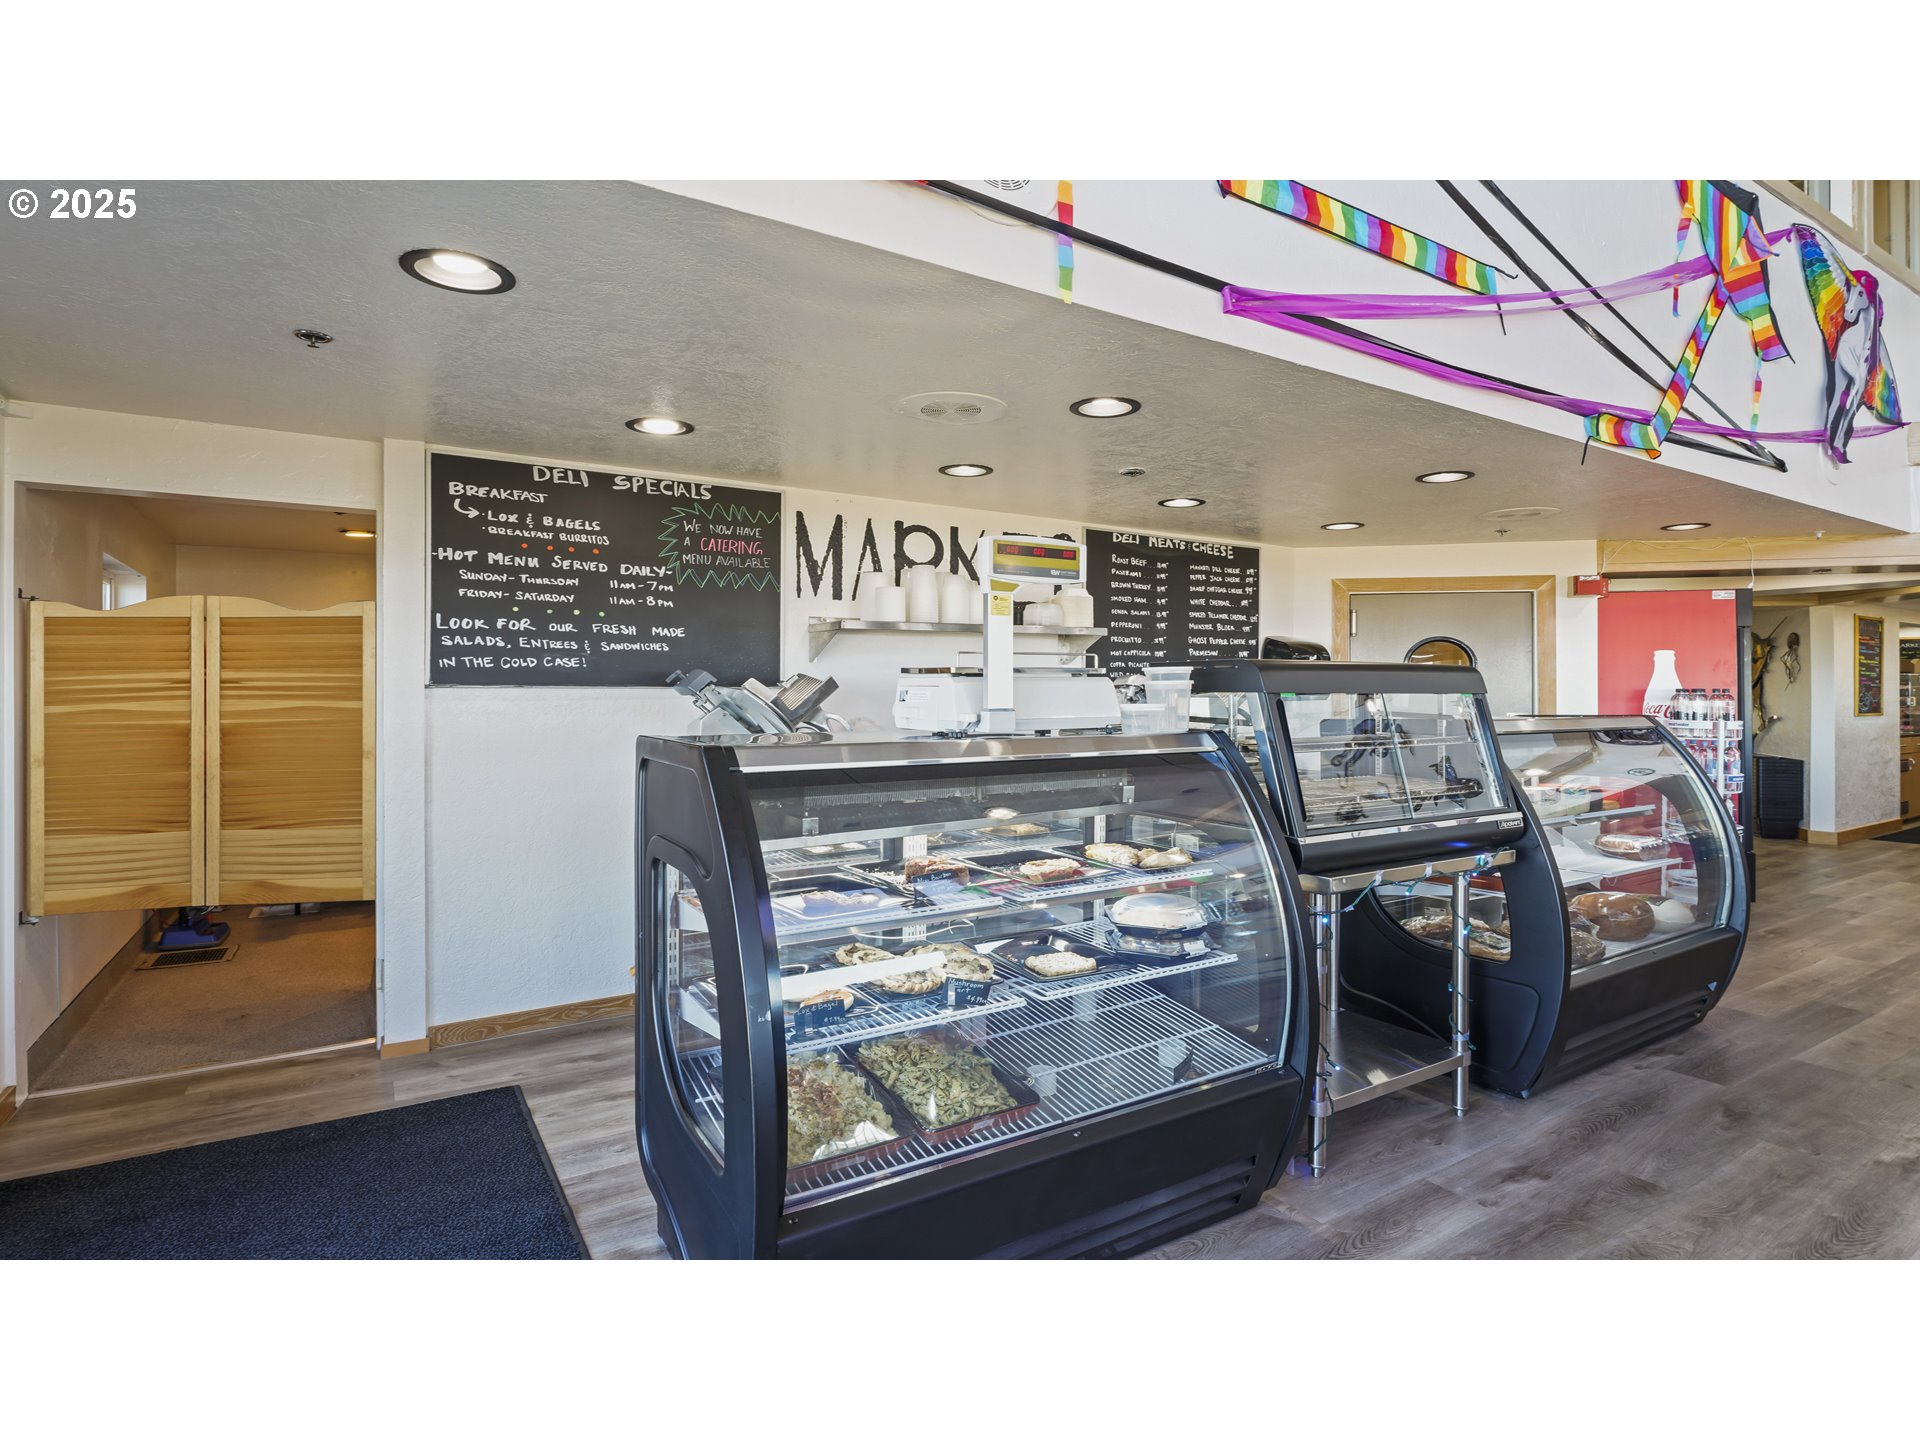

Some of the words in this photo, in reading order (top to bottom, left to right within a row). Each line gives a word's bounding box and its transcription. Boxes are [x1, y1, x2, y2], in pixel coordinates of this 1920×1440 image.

[532, 465, 590, 488] DELI
[612, 475, 713, 500] SPECIALS
[448, 481, 549, 503] BREAKFAST
[487, 510, 519, 523] LOX
[542, 515, 601, 531] BAGELS
[683, 518, 702, 534] WE
[709, 523, 733, 536] NOW
[736, 526, 763, 539] HAVE
[487, 525, 554, 540] BREAKFAST
[558, 532, 610, 546] BURRITOS
[683, 536, 691, 547] A
[700, 537, 764, 556] CATERING
[1112, 532, 1140, 545] DELI
[1148, 536, 1186, 550] MEATS
[1192, 542, 1234, 559] CHEESE
[487, 552, 540, 569] MENU
[551, 555, 609, 573] SERVED
[682, 553, 712, 565] MENU
[715, 555, 772, 569] AVAILABLE
[1111, 553, 1129, 565] ROAST
[1130, 556, 1147, 567] BEEF
[518, 574, 580, 586] THURSDAY
[514, 590, 575, 603] SATURDAY
[435, 612, 490, 630] LOOK
[496, 618, 537, 631] FOR
[548, 622, 579, 633] OUR
[591, 623, 637, 636] FRESH
[651, 626, 686, 638] MADE
[1110, 621, 1142, 629] PEPPERONI
[440, 635, 512, 649] SALADS,
[518, 636, 579, 650] ENTREES
[600, 641, 669, 652] SANDWICHES
[1187, 636, 1207, 645] GHOST
[438, 656, 456, 668] IN
[460, 656, 495, 668] THE
[500, 656, 538, 668] COLD
[543, 656, 588, 668] CASE!
[948, 977, 984, 990] Mushroom
